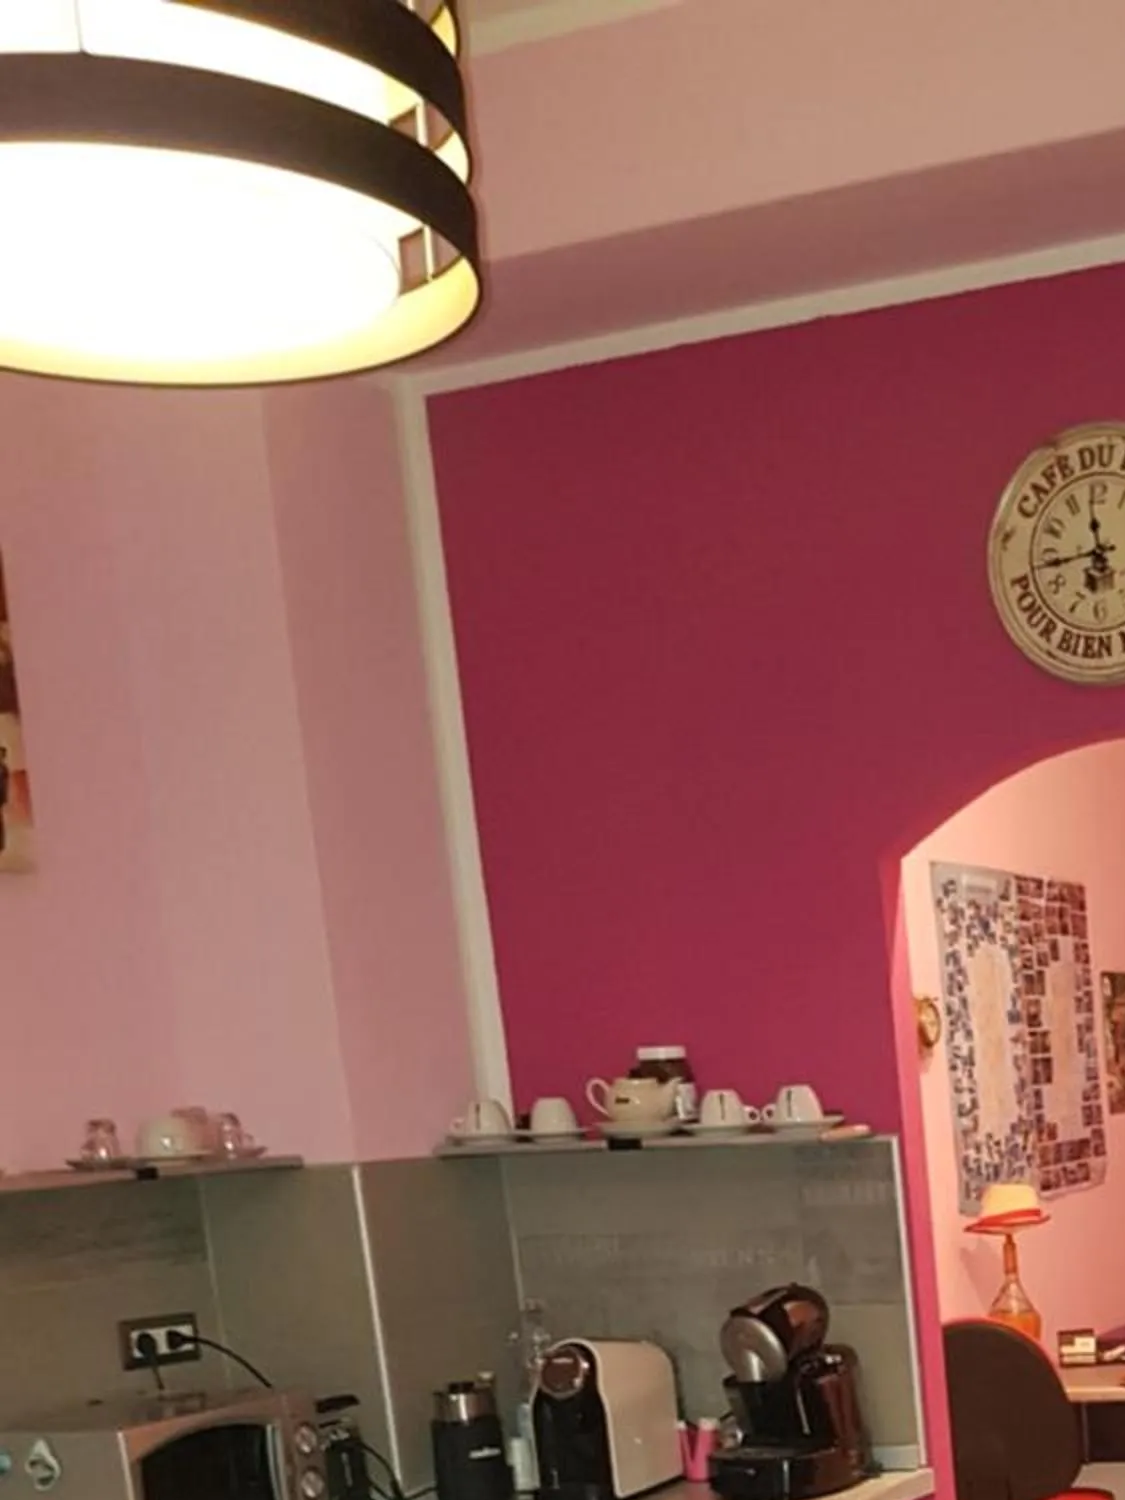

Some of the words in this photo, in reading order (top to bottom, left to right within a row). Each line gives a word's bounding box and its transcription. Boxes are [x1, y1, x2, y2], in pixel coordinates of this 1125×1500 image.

[1077, 444, 1116, 471] DU
[1009, 573, 1058, 644] POUR
[1056, 629, 1113, 659] BIEN
